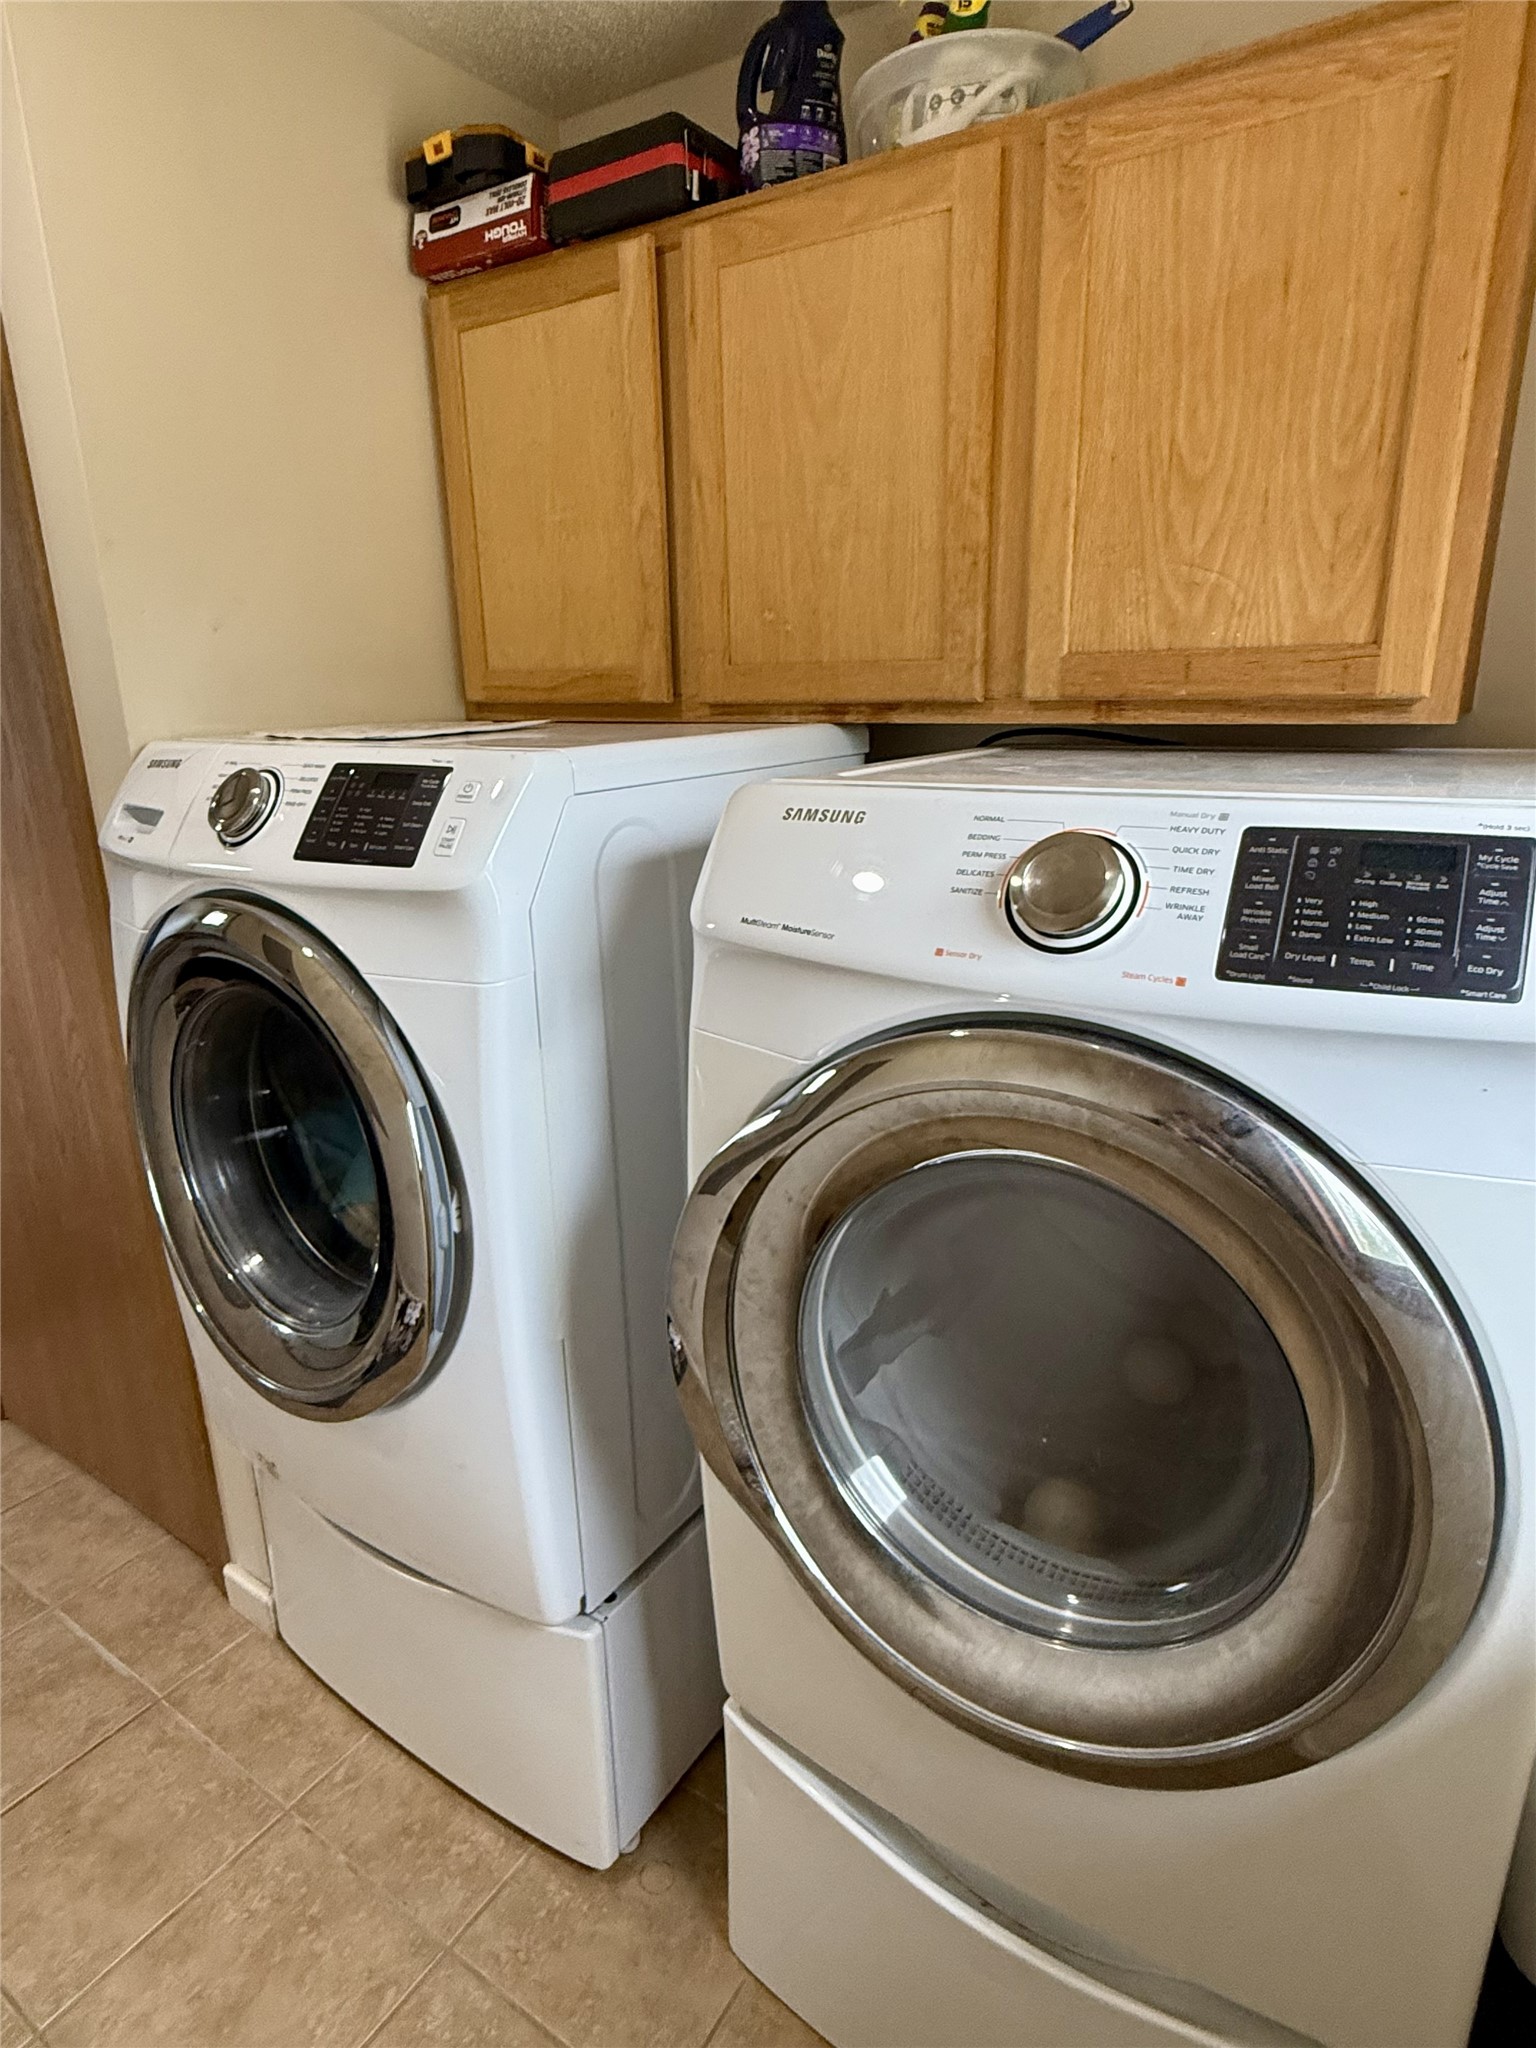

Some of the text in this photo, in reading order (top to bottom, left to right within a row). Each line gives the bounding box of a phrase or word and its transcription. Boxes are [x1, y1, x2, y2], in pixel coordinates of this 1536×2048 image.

[484, 219, 527, 243] TOUGH
[147, 759, 182, 769] SAMSUNG
[782, 807, 867, 824] SAMSUNG
[973, 815, 1005, 823] NORMAL
[1170, 811, 1217, 821] Manual Dry
[1169, 825, 1226, 835] HEAVY DUTY
[967, 833, 1001, 842] BEDDING
[1172, 846, 1221, 856] QUICK DRY
[1248, 846, 1290, 855] Anti Static
[984, 852, 1007, 860] PRESS
[1478, 854, 1520, 865] My Cycle
[956, 868, 995, 878] DELICATES
[1173, 865, 1215, 876] TIME DRY
[950, 886, 983, 896] SANITIZE
[1169, 886, 1210, 896] REFRESH
[1244, 882, 1263, 890] Load
[1478, 888, 1508, 898] Adjust
[1304, 897, 1324, 906] Very
[1357, 900, 1378, 909] High
[1477, 897, 1500, 907] Time
[1165, 902, 1206, 913] WRINKLE
[1243, 908, 1273, 916] Wrinkle
[1302, 908, 1323, 917] More
[1176, 913, 1204, 922] AWAY
[1240, 916, 1272, 925] Prevent
[1357, 911, 1390, 920] Medium
[1416, 916, 1445, 925] 60min
[1300, 919, 1330, 928] Normal
[1355, 923, 1373, 931] Low
[1414, 927, 1443, 936] 40min
[1476, 924, 1506, 934] Adjust
[1298, 931, 1322, 940] Damp
[1353, 934, 1395, 945] Extra Low
[1474, 932, 1498, 942] Time
[1413, 939, 1442, 948] 20min
[945, 950, 983, 961] Sensor Dry
[1229, 950, 1248, 959] Load
[1284, 951, 1326, 963] Dry Level
[1349, 957, 1376, 968] Temp.
[1411, 962, 1435, 973] Time
[1467, 964, 1504, 977] Eco Dry
[1122, 971, 1174, 984] Steam Cycles
[1392, 985, 1410, 993] Lock
[1488, 990, 1508, 1000] Care
